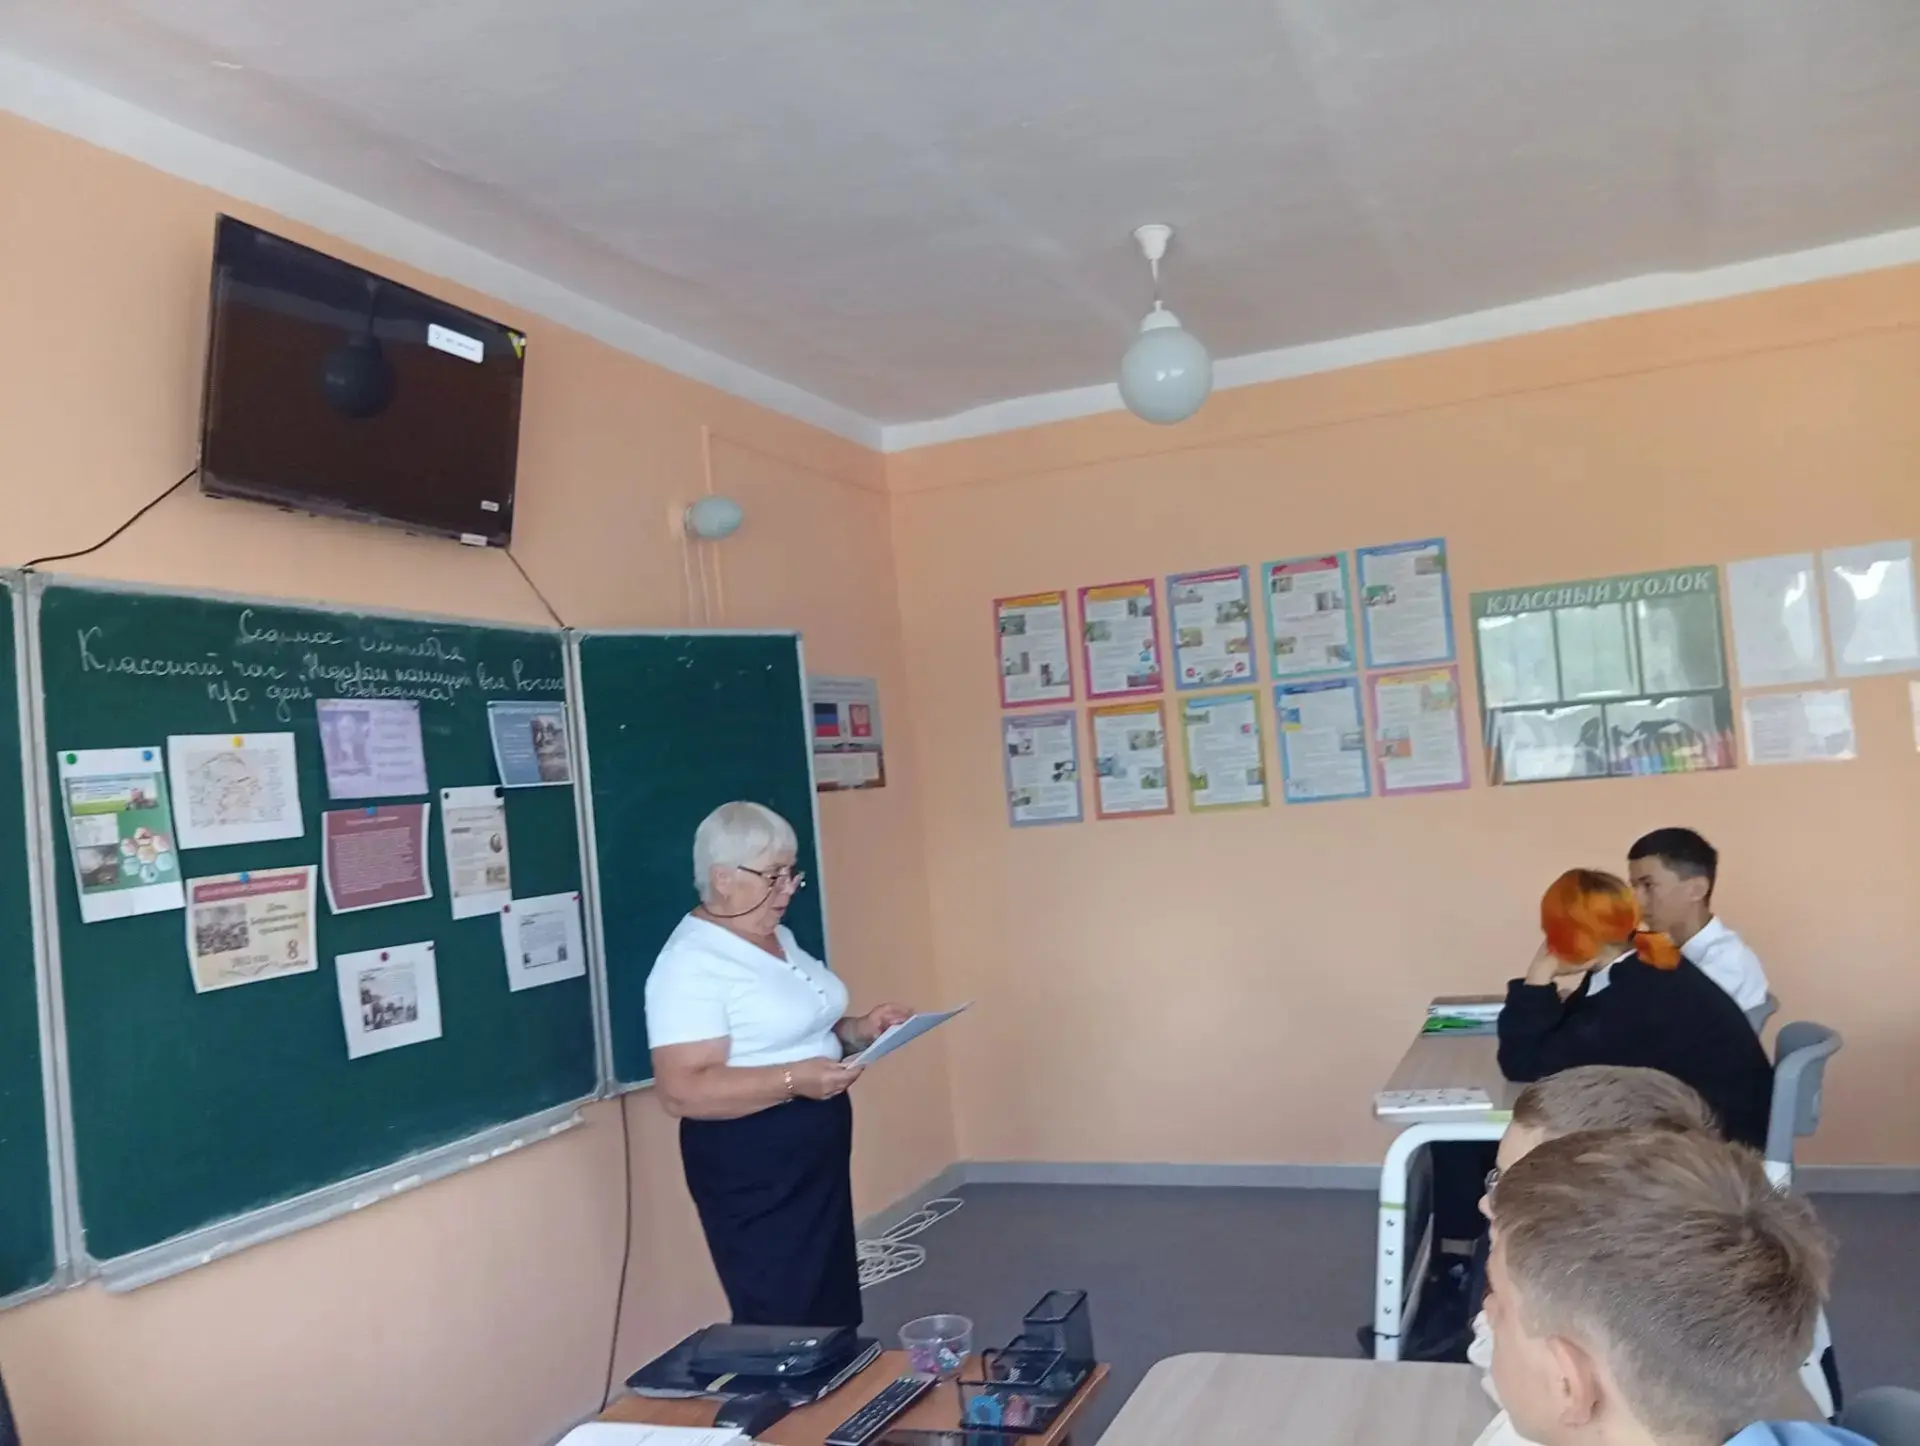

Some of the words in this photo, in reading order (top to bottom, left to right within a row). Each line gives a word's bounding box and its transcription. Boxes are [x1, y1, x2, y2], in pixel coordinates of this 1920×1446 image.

[1486, 582, 1611, 615] КЛАССНЫЙ
[1616, 571, 1712, 600] УГОЛОК
[77, 626, 223, 676] Классный
